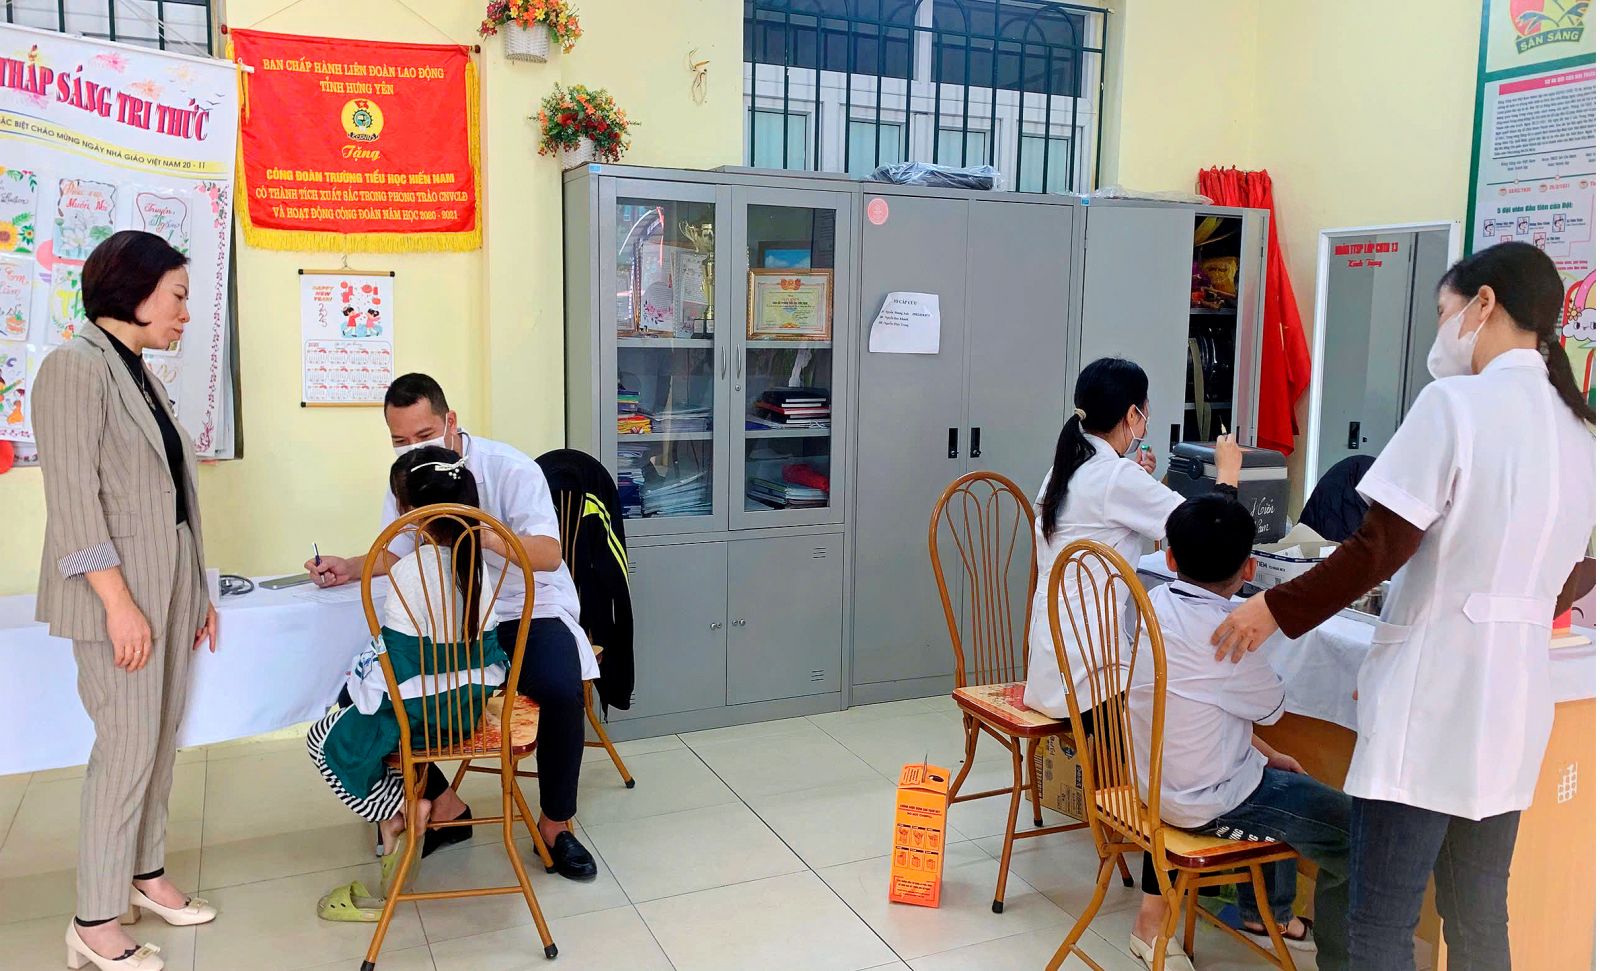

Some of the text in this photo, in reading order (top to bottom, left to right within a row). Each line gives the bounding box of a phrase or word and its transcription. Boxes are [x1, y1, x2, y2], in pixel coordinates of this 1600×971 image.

[263, 56, 444, 81] BAN CHẤP HÀNH LIÊN ĐOÀN LAO ĐỘNG
[320, 77, 394, 95] TỈNH HƯNG YÊN
[56, 65, 113, 117] SÁNG
[117, 91, 152, 130] TRI
[155, 98, 210, 141] THỨC
[14, 119, 29, 131] BIỆT
[82, 139, 105, 154] NGÀY
[106, 147, 122, 160] NHÀ
[124, 151, 145, 164] GIÁO
[147, 155, 162, 169] VIỆT
[162, 160, 182, 169] NAM
[182, 161, 191, 169] 20
[342, 145, 381, 162] Tặng
[266, 167, 293, 180] CÔNG
[295, 169, 322, 182] ĐOÀN
[324, 170, 363, 183] TRƯỜNG
[364, 169, 385, 183] TIỂU
[388, 173, 406, 186] HỌC
[432, 173, 454, 183] NAM
[256, 185, 267, 199] CÓ
[268, 186, 298, 200] THÀNH
[299, 186, 318, 200] TÍCH
[320, 186, 341, 201] XUẤT
[343, 186, 358, 201] SẮC
[359, 190, 387, 201] TRONG
[388, 191, 415, 202] PHONG
[416, 189, 438, 202] TRÀO
[272, 205, 285, 218] VÀ
[286, 207, 309, 220] HOẠT
[311, 206, 334, 221] ĐỘNG
[335, 206, 357, 220] CÔNG
[358, 207, 381, 219] ĐOÀN
[382, 207, 401, 220] NĂM
[402, 210, 419, 222] HỌC
[420, 211, 436, 220] 2020
[441, 210, 458, 220] 2021
